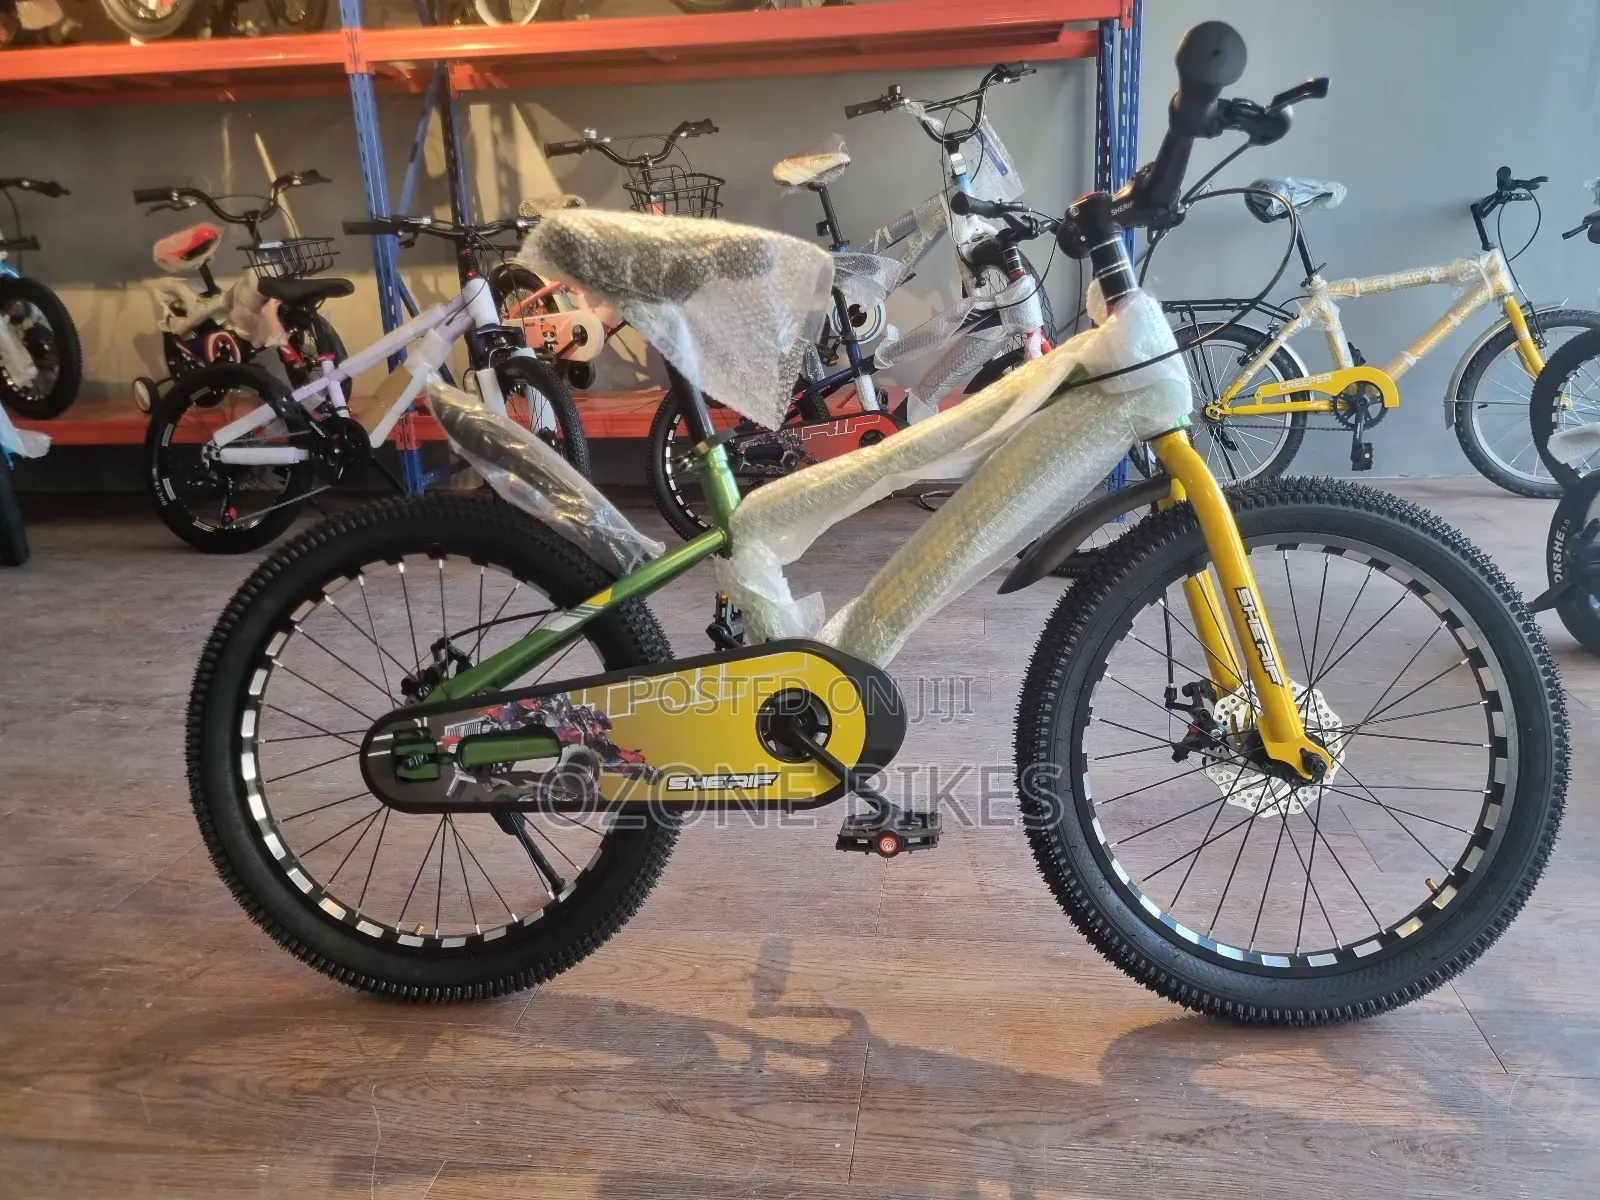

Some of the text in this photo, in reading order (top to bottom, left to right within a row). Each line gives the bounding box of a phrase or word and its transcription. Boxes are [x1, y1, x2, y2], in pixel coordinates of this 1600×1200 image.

[1110, 200, 1134, 216] SHERIF
[1279, 373, 1333, 390] CREEPER
[1235, 587, 1284, 688] SHERIF
[667, 773, 778, 791] SHERIF
